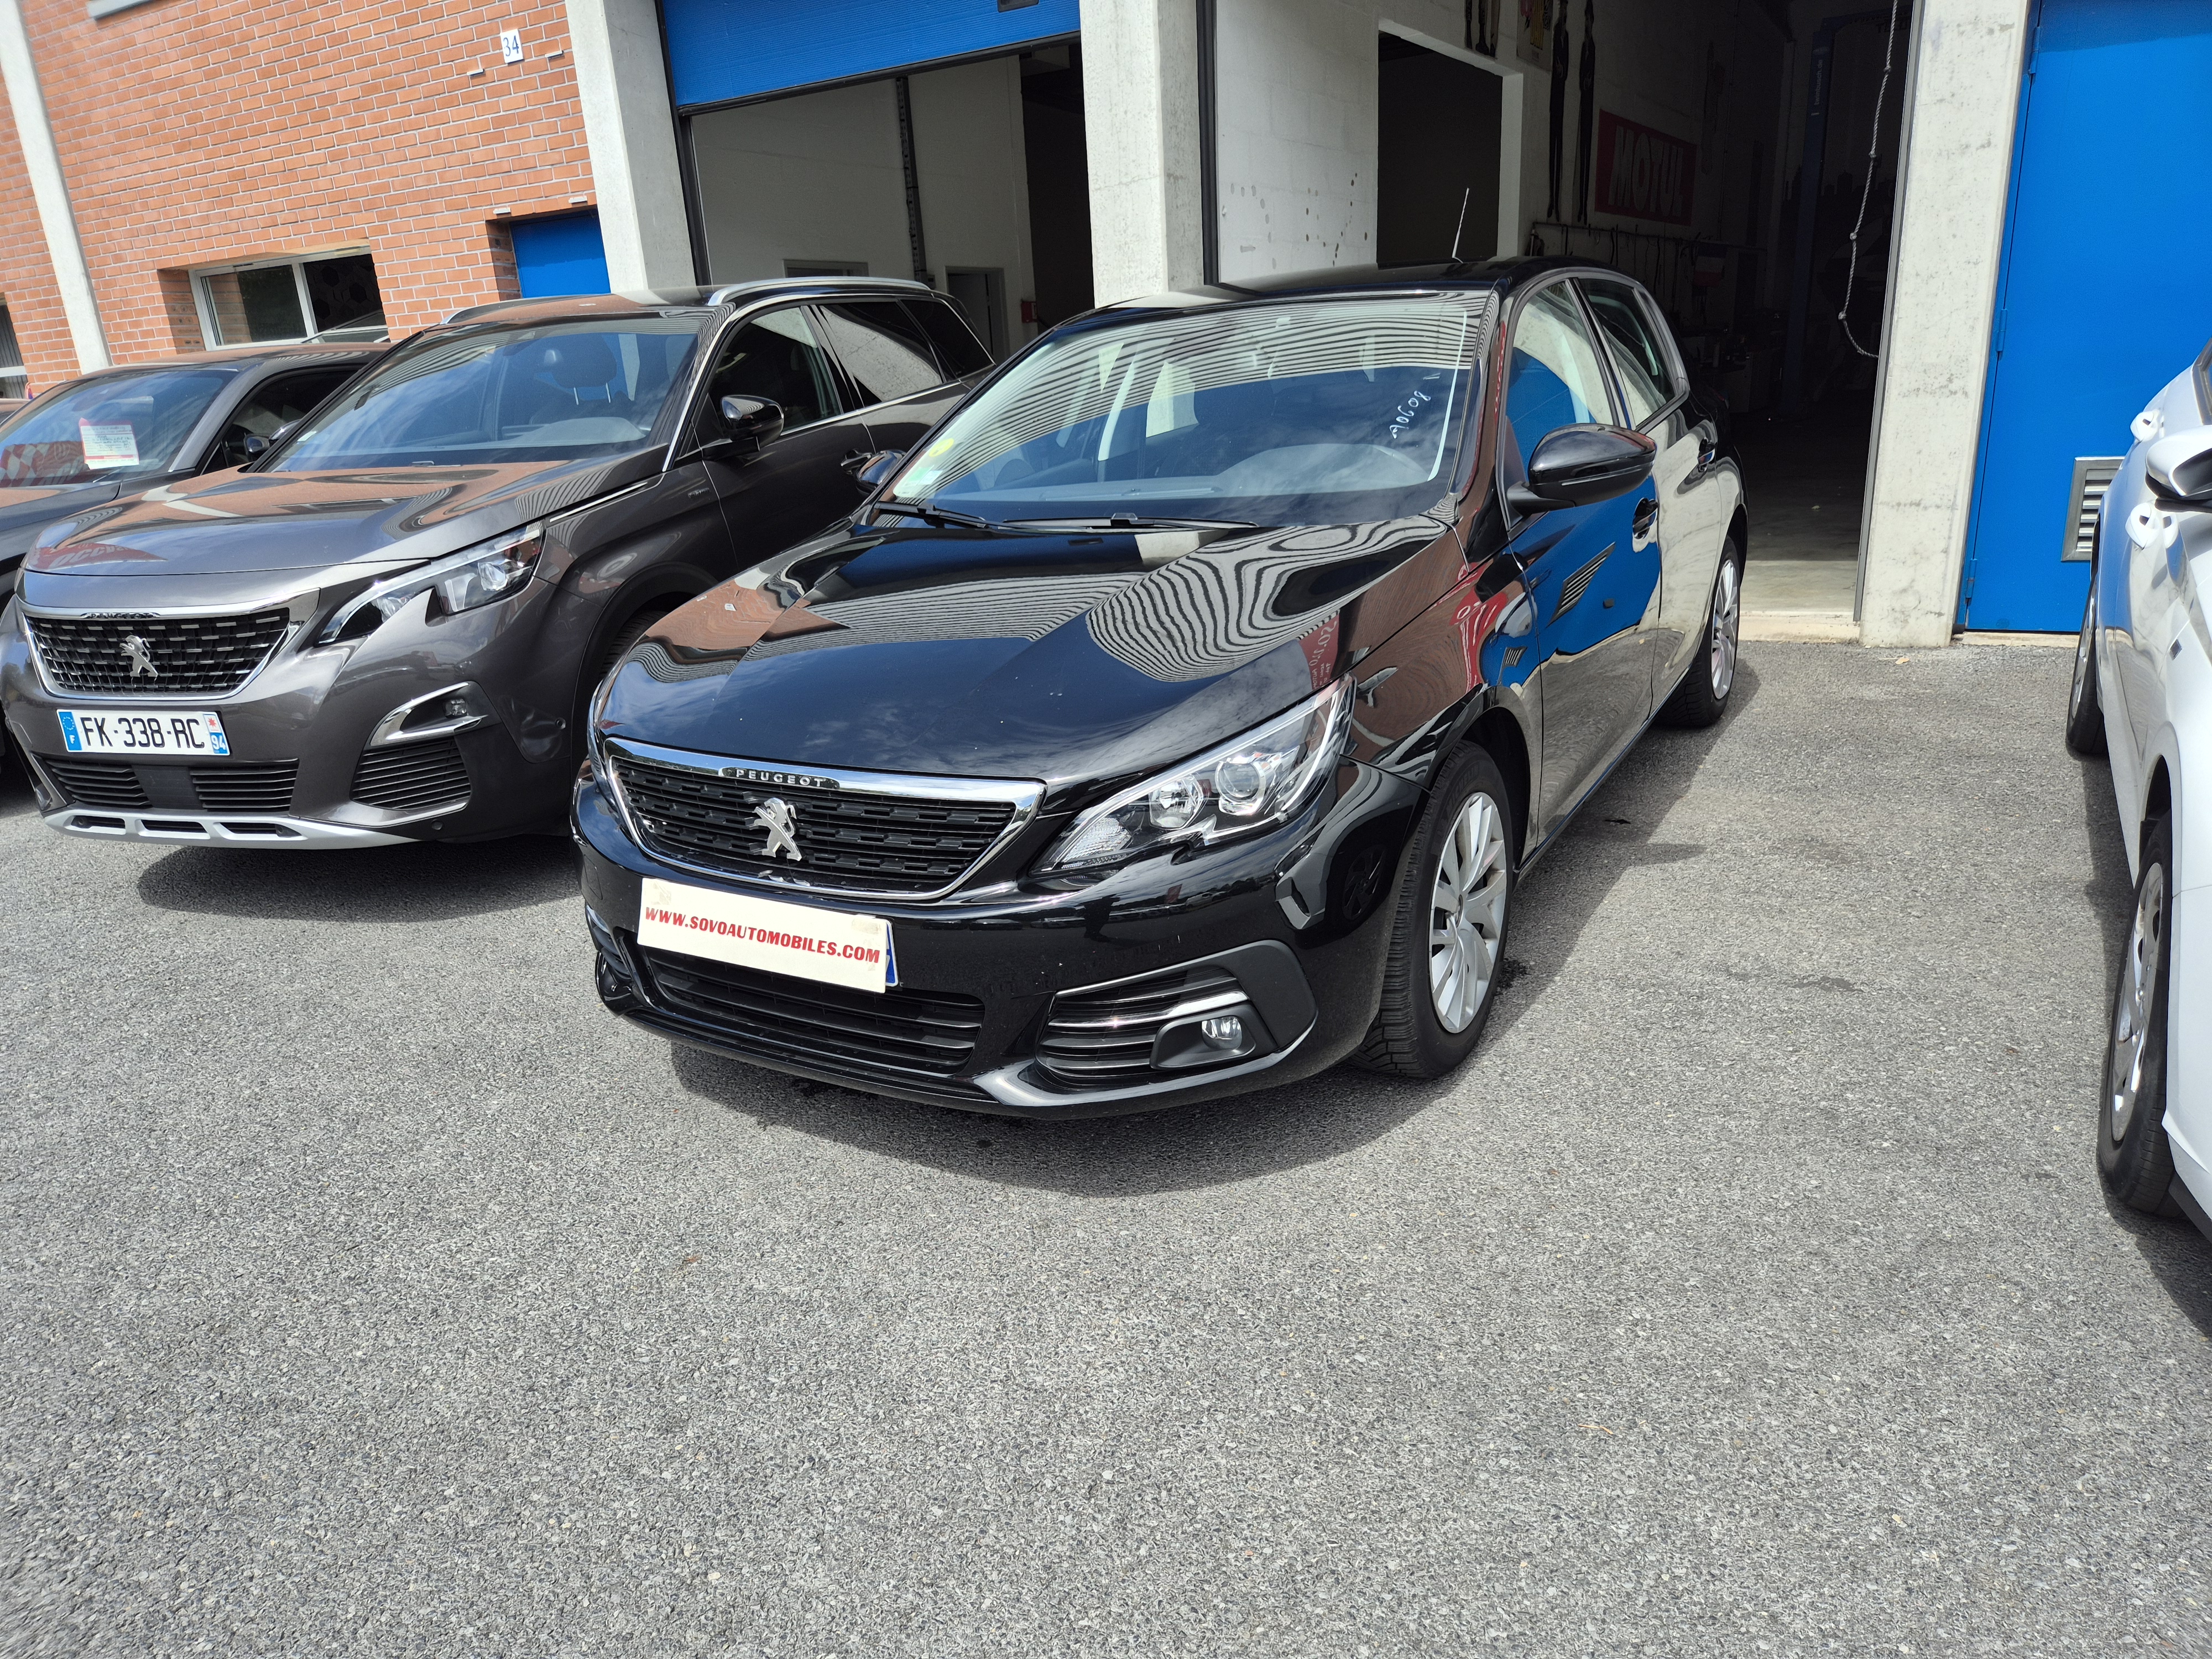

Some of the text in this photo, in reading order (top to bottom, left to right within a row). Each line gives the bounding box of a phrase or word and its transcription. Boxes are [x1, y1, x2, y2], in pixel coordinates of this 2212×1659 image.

[503, 35, 519, 57] 34
[1814, 59, 1823, 106] twinbusch.de
[1608, 126, 1683, 218] MOTUL
[69, 734, 76, 744] F
[80, 717, 205, 749] FK-338-RC
[211, 734, 227, 750] 94
[735, 768, 825, 787] PEUGEOT
[645, 906, 880, 963] WWW.SOVOAUTOMOBILES.COM
